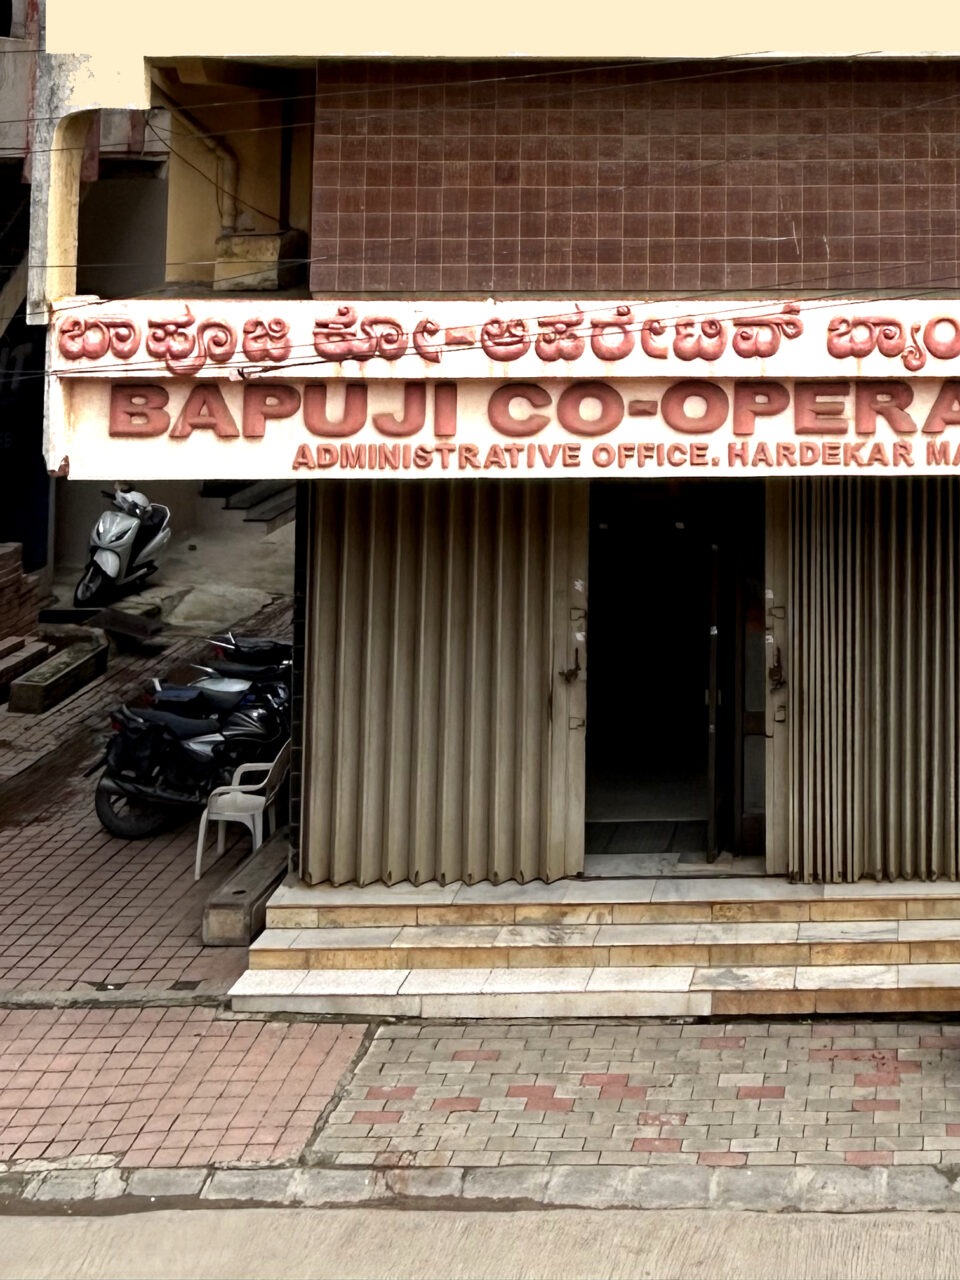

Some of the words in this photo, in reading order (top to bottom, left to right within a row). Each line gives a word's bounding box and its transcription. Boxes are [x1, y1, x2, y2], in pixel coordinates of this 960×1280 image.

[59, 305, 292, 375] ಬಾಪೂಜಿ
[108, 382, 458, 439] BAPUJI
[292, 441, 581, 471] ADMINISTRATIVE
[727, 438, 915, 469] HARDEKAR
